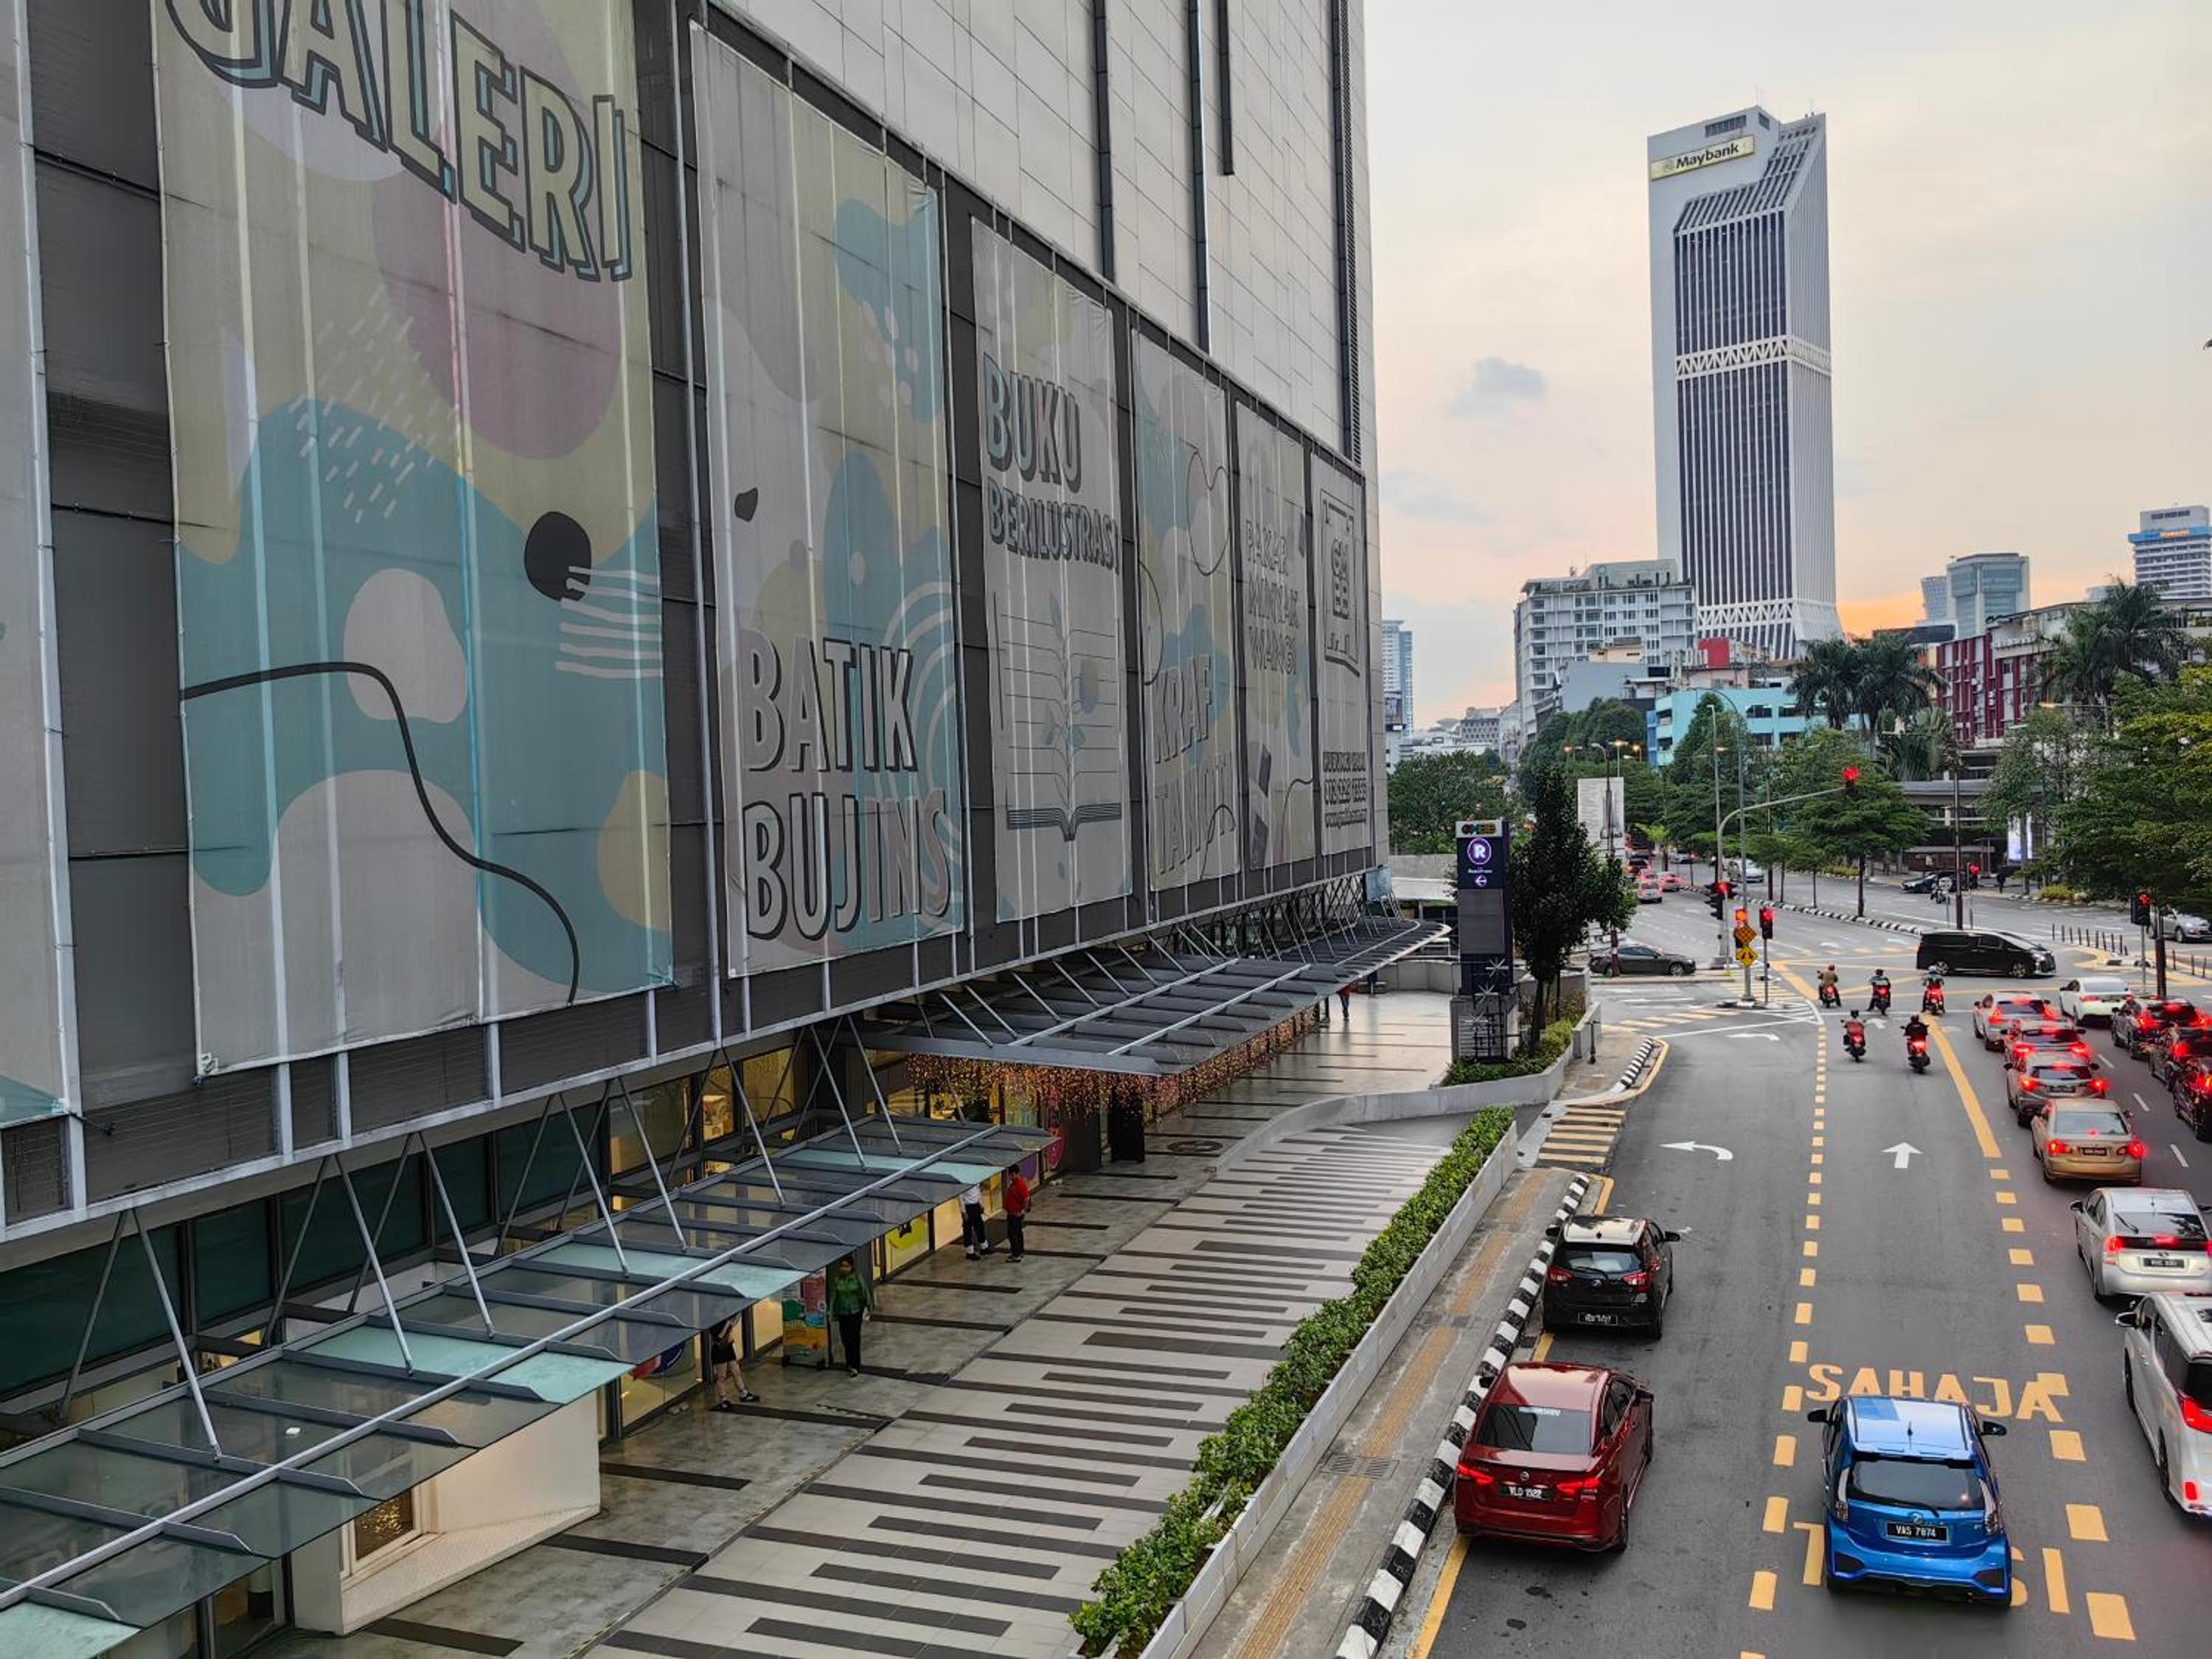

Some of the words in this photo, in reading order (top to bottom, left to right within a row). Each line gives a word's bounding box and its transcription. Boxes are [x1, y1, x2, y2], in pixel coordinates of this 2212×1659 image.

[167, 0, 632, 282] ALERI
[1676, 142, 1739, 169] Maybank
[984, 351, 1082, 493] BUKU
[987, 476, 1119, 575] BERILUSTRASI
[738, 625, 918, 772] BATIK
[1248, 625, 1297, 675] WANGI
[1152, 652, 1211, 764] KRAF
[743, 787, 951, 941] BUJINS
[1473, 844, 1486, 859] R
[1806, 1363, 2065, 1422] SAHAJA
[1896, 1524, 1912, 1536] VAS
